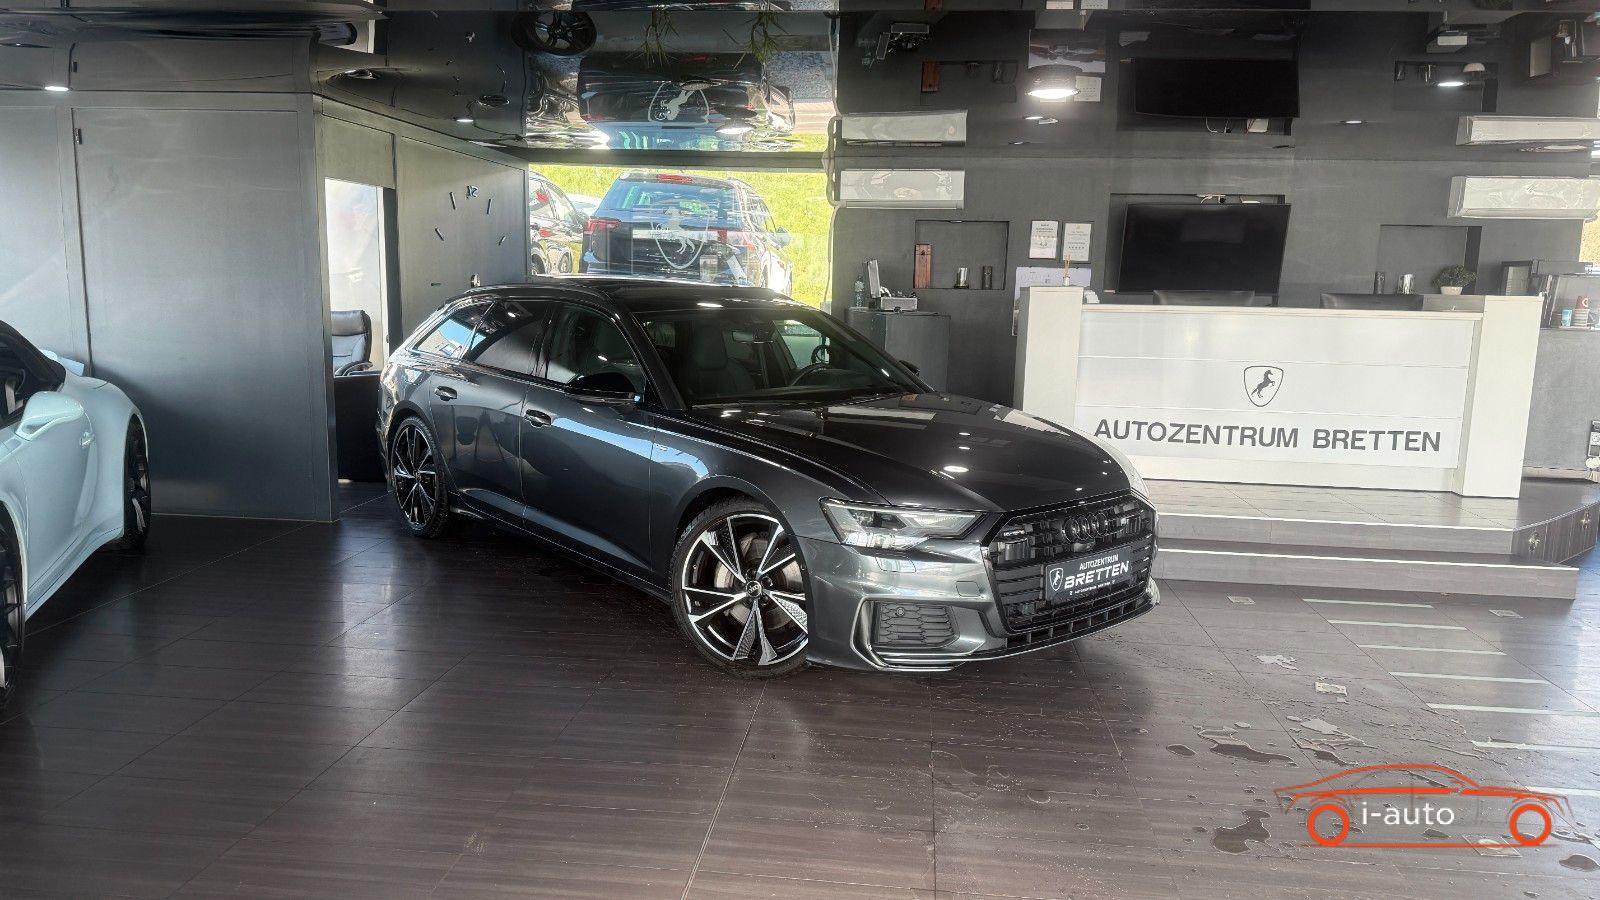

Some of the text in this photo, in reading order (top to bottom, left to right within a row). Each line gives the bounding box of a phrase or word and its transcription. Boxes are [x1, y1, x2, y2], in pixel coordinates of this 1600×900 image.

[1093, 420, 1441, 452] AUTOZENTRUM BRETTEN
[1064, 561, 1130, 589] BRETTEN
[1079, 554, 1119, 570] AUTOZENTRUM
